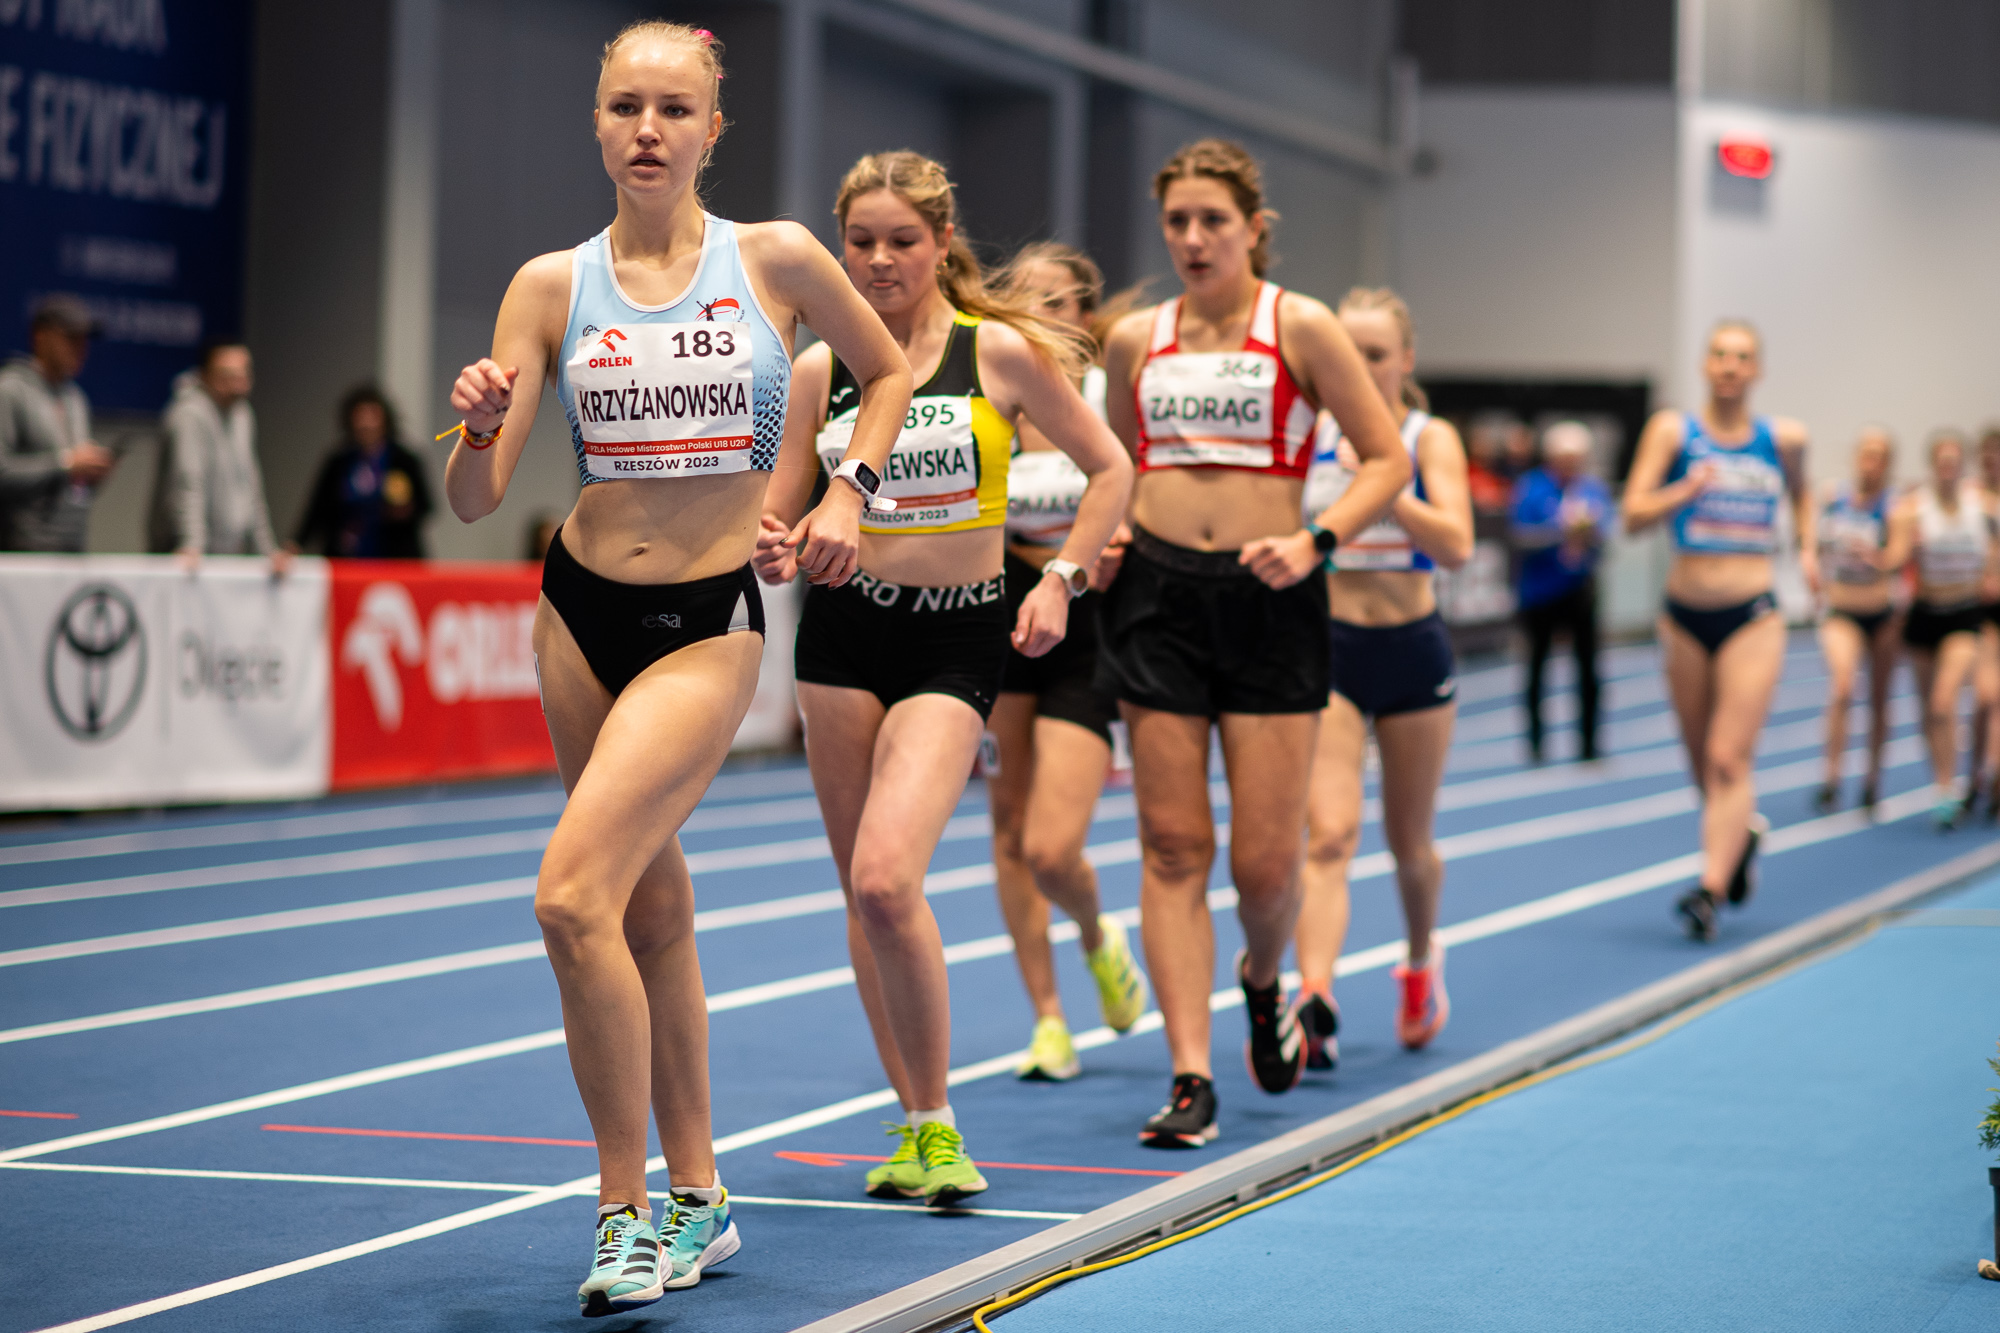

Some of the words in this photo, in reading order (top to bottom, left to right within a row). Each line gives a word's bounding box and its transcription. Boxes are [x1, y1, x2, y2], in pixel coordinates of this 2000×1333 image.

[671, 330, 735, 359] 183
[589, 356, 632, 369] ORLEN
[1216, 360, 1262, 378] 364
[579, 379, 748, 423] KRZYŻANOWSKA
[1150, 397, 1261, 428] ZADRĄG
[606, 445, 635, 454] Halowe
[636, 443, 687, 453] Mistrzostwa
[687, 441, 712, 450] Polski
[713, 440, 728, 448] U18
[729, 438, 746, 447] U20
[613, 456, 680, 471] RZESZÓW
[684, 456, 719, 469] 2023
[862, 510, 915, 523] RZESZÓW
[918, 508, 949, 521] 2023
[851, 570, 901, 608] RO
[911, 580, 999, 612] NIKE
